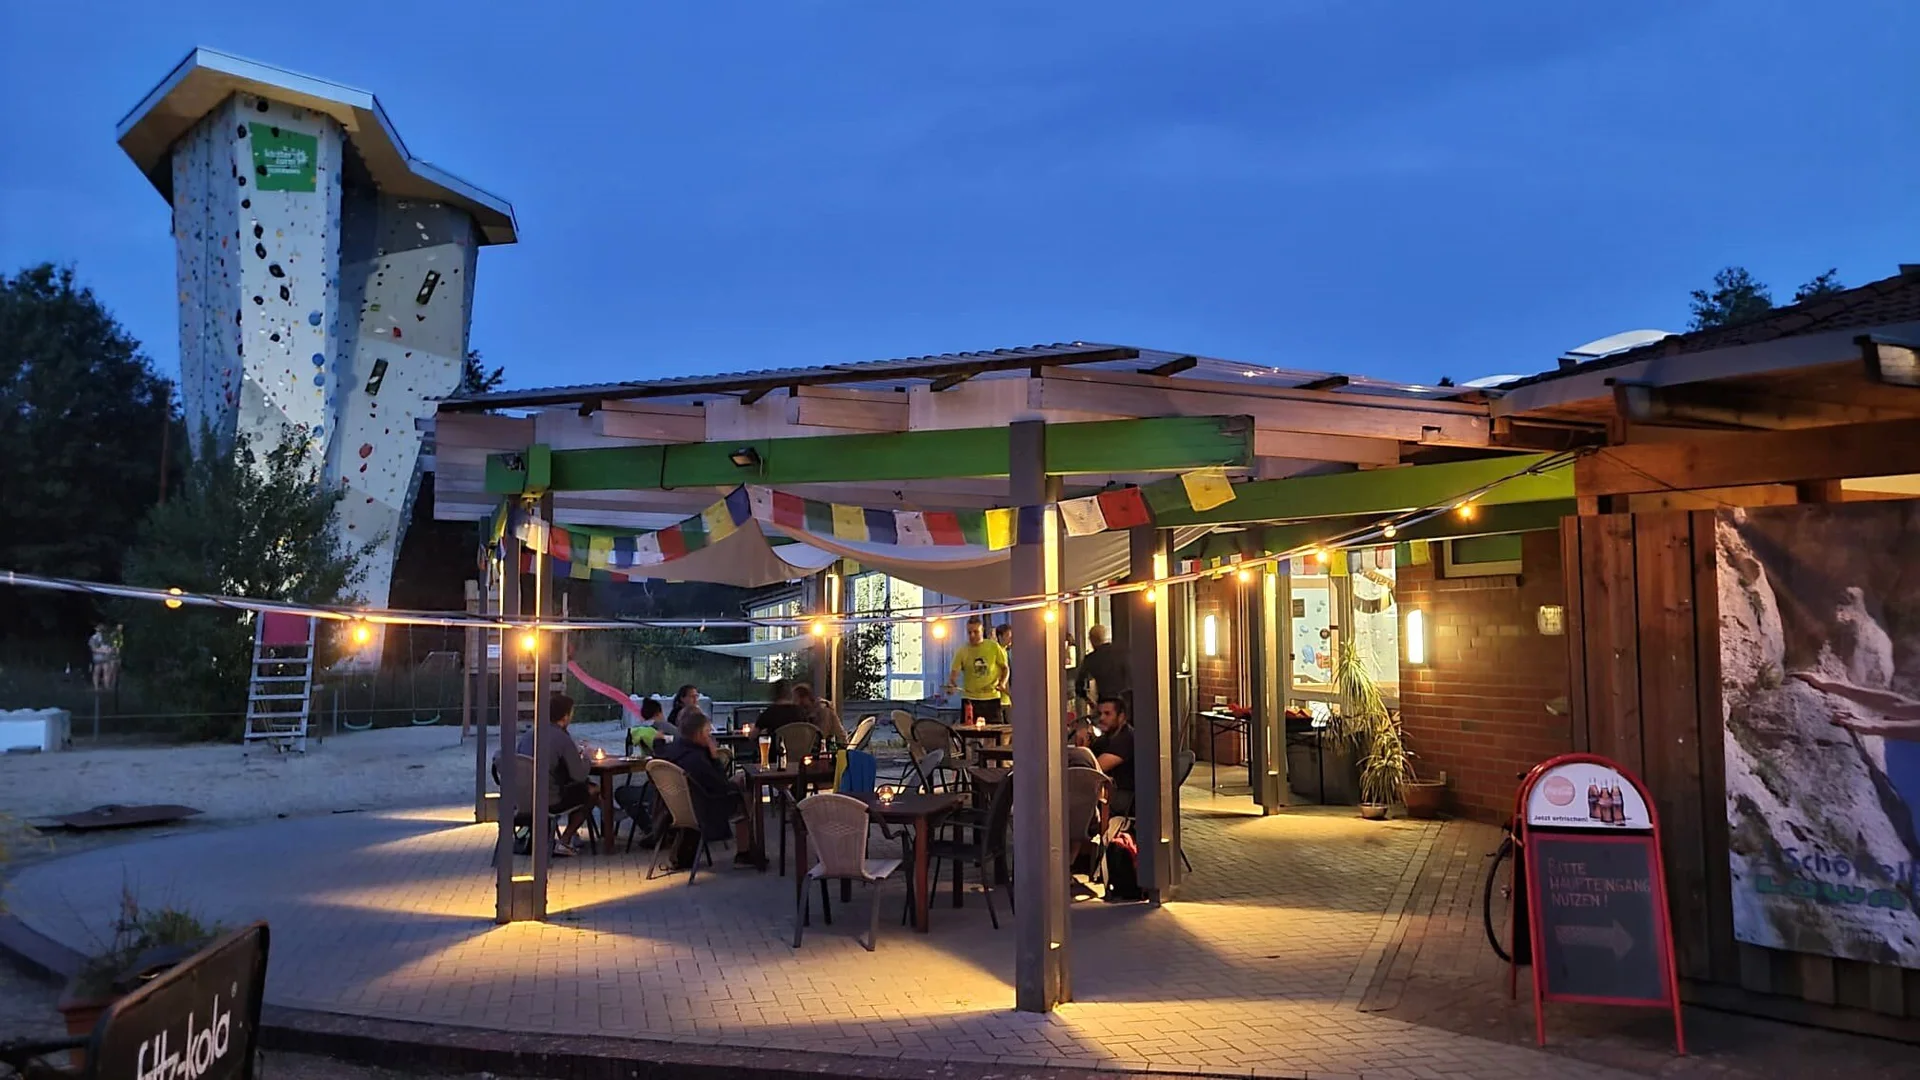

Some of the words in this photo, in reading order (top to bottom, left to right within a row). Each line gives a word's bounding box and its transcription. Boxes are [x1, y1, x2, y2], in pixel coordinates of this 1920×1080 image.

[1548, 857, 1587, 875] BITTE
[1783, 847, 1906, 883] Schöel
[1549, 876, 1651, 893] HAUPTENGANG
